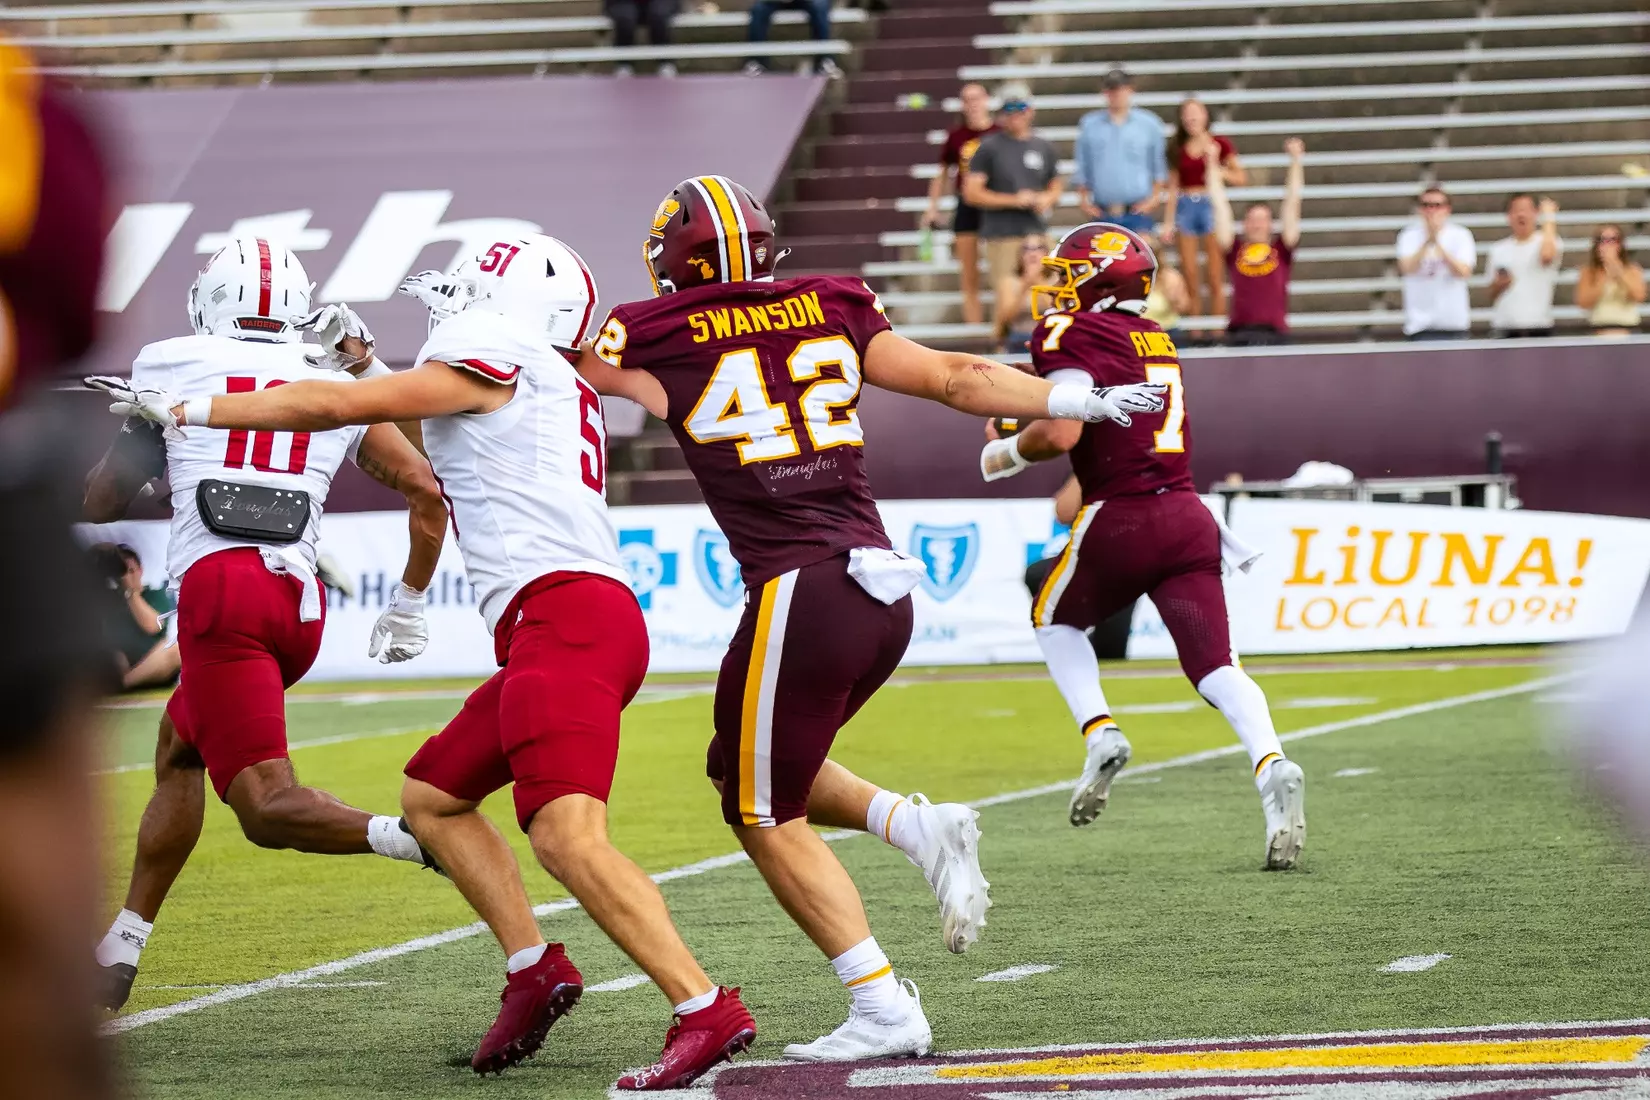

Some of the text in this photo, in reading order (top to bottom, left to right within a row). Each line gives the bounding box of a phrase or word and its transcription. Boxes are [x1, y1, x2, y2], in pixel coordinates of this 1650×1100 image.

[479, 242, 521, 277] 51
[240, 319, 281, 331] RAIDERS
[687, 291, 826, 343] SWANSON
[1042, 314, 1075, 352] 7
[683, 335, 865, 466] 42
[1145, 363, 1185, 453] 7
[1283, 525, 1595, 587] LiUNA!
[1275, 597, 1577, 631] LOCAL 1098
